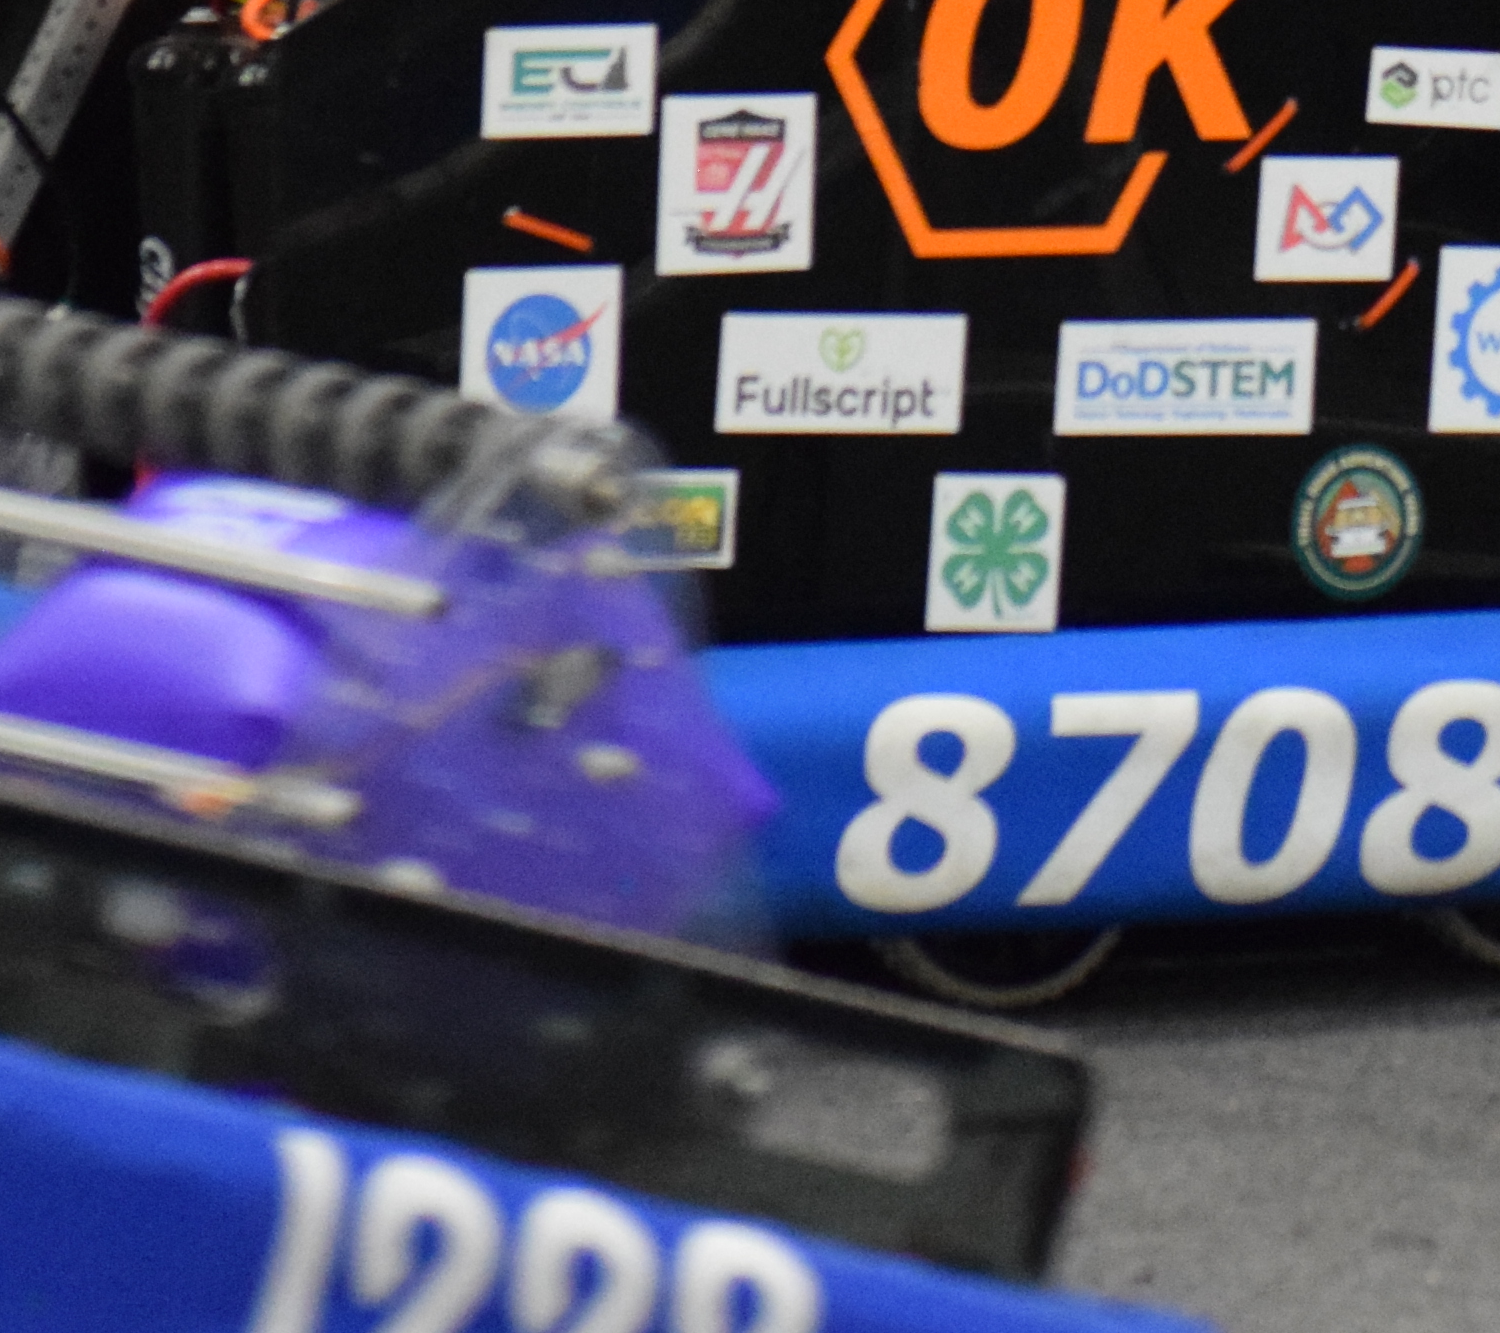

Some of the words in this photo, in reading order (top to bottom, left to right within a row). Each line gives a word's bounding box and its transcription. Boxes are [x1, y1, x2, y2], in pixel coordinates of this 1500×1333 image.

[1429, 68, 1490, 110] ptc
[493, 337, 587, 373] NASA
[1077, 359, 1296, 400] DoDSTEM
[734, 373, 936, 429] Fullscript
